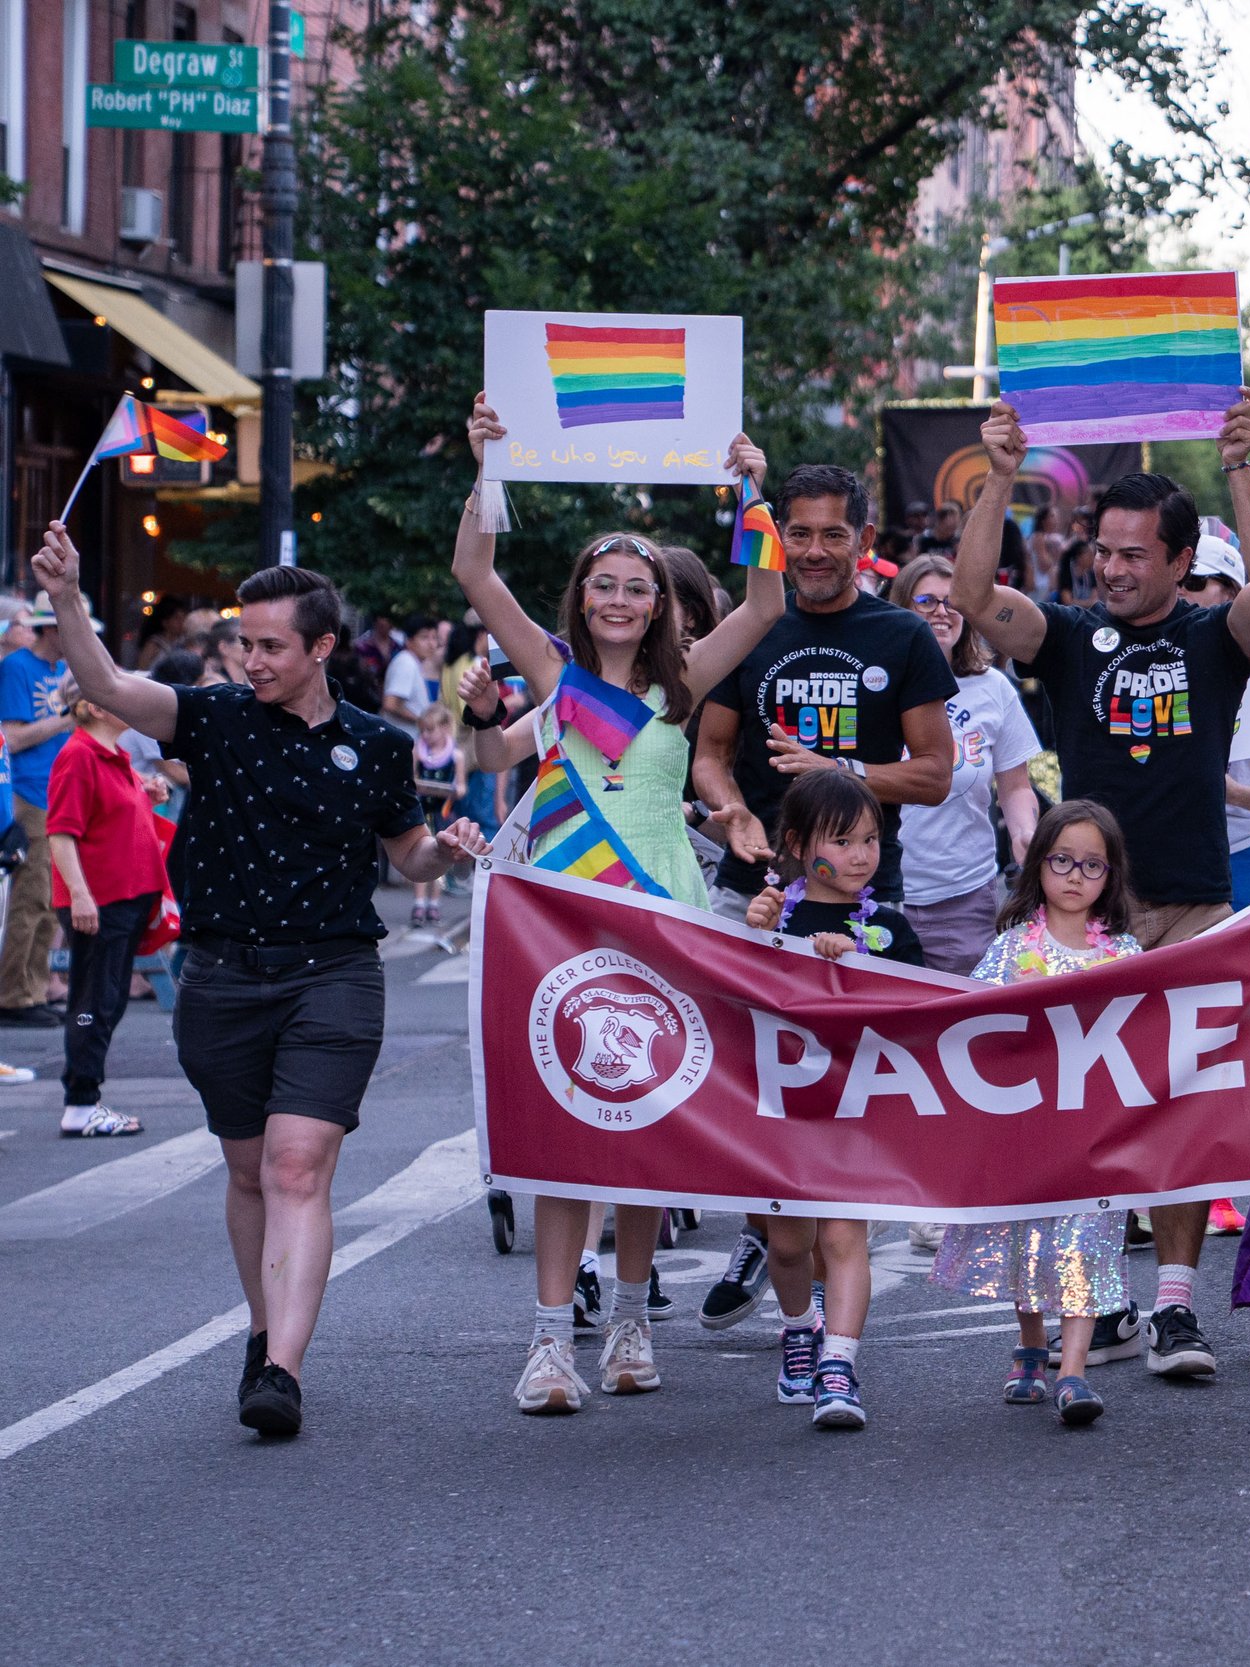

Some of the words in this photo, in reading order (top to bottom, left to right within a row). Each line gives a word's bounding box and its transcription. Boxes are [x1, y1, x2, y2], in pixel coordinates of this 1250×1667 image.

[133, 44, 218, 84] Degraw
[229, 47, 244, 68] St
[91, 87, 152, 112] Robert
[159, 90, 207, 113] "PH"
[213, 94, 250, 117] Diaz
[509, 441, 541, 467] Be
[551, 443, 597, 464] who
[608, 444, 648, 468] you
[756, 681, 769, 716] PACKER
[765, 647, 817, 681] COLLEGIATE
[819, 647, 864, 671] INSTITUTE
[775, 678, 858, 706] PRIDE
[809, 672, 859, 681] BROOKLYN
[1092, 671, 1111, 703] PACKER
[1113, 666, 1189, 698] PRIDE
[1092, 700, 1106, 723] THE
[1109, 692, 1193, 737] LOVE
[776, 706, 858, 750] LOVE
[582, 954, 676, 998] COLLEGIATE
[536, 967, 578, 1027] PACKER
[582, 990, 620, 1002] MACTE
[623, 995, 665, 1012] VIRTUTE
[537, 1033, 554, 1070] THE
[678, 997, 706, 1086] INSTITUTE
[597, 1107, 633, 1123] 1845
